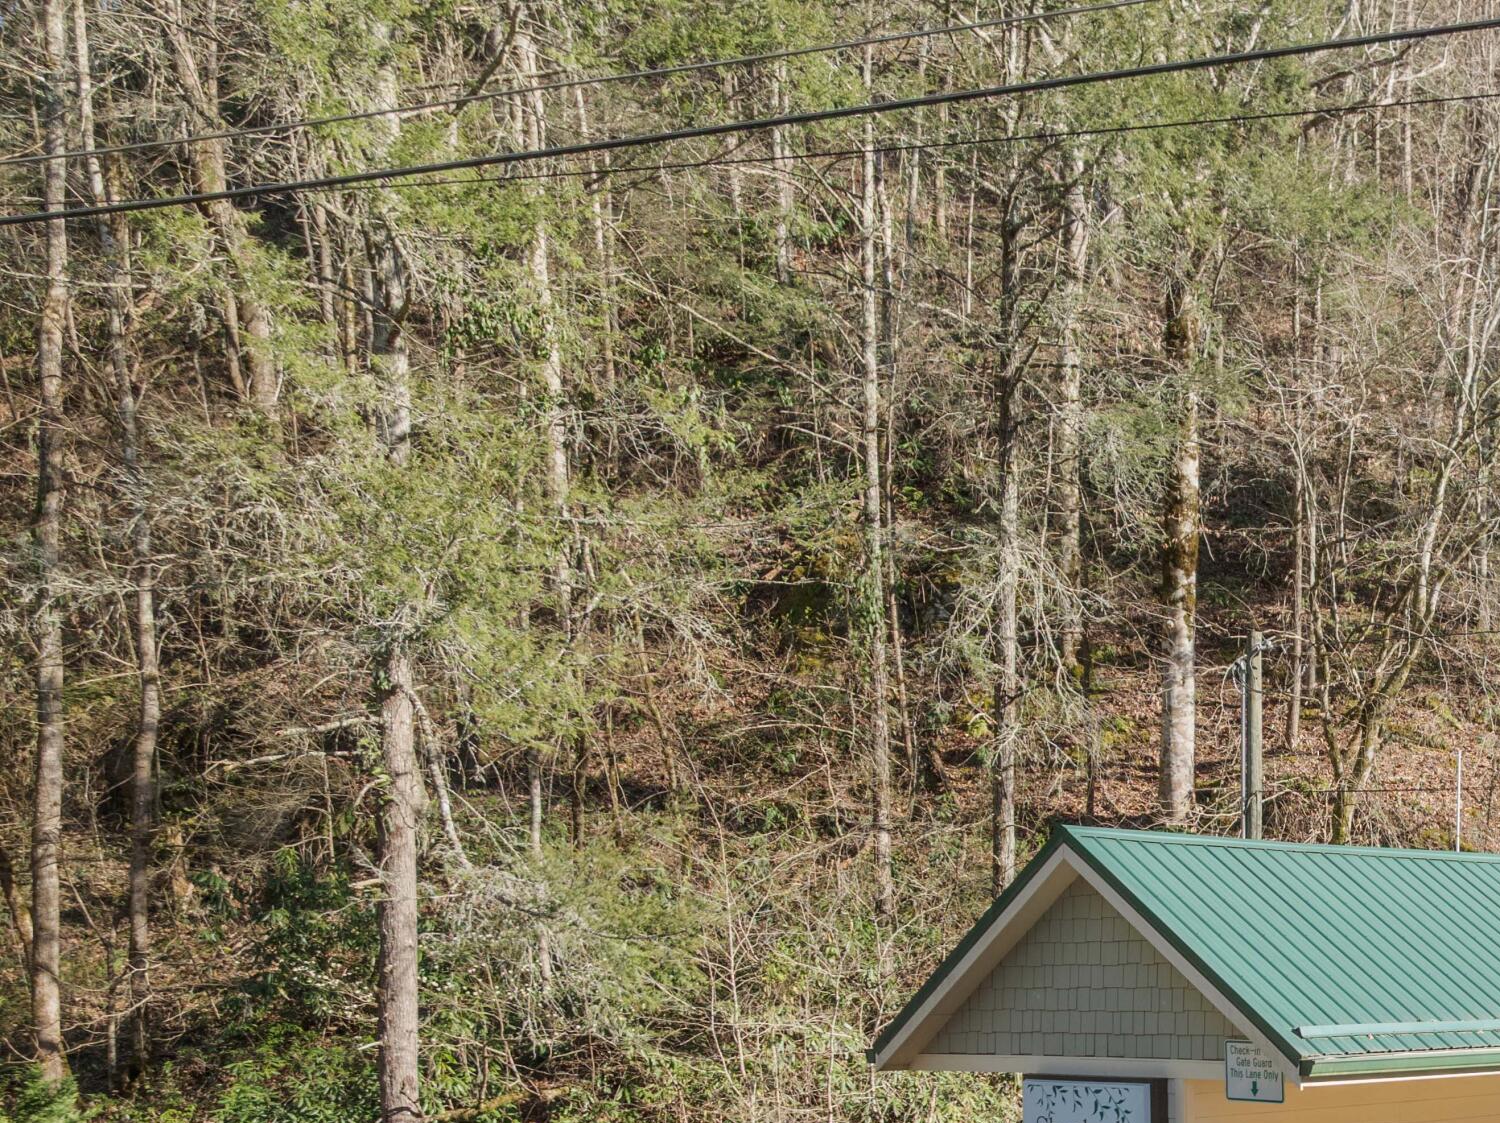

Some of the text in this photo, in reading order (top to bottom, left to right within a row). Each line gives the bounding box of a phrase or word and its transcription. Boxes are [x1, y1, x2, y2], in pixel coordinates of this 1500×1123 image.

[1230, 1045, 1261, 1055] Check-in
[1236, 1057, 1273, 1068] Gate Guard
[1230, 1068, 1278, 1082] This Lane Only
